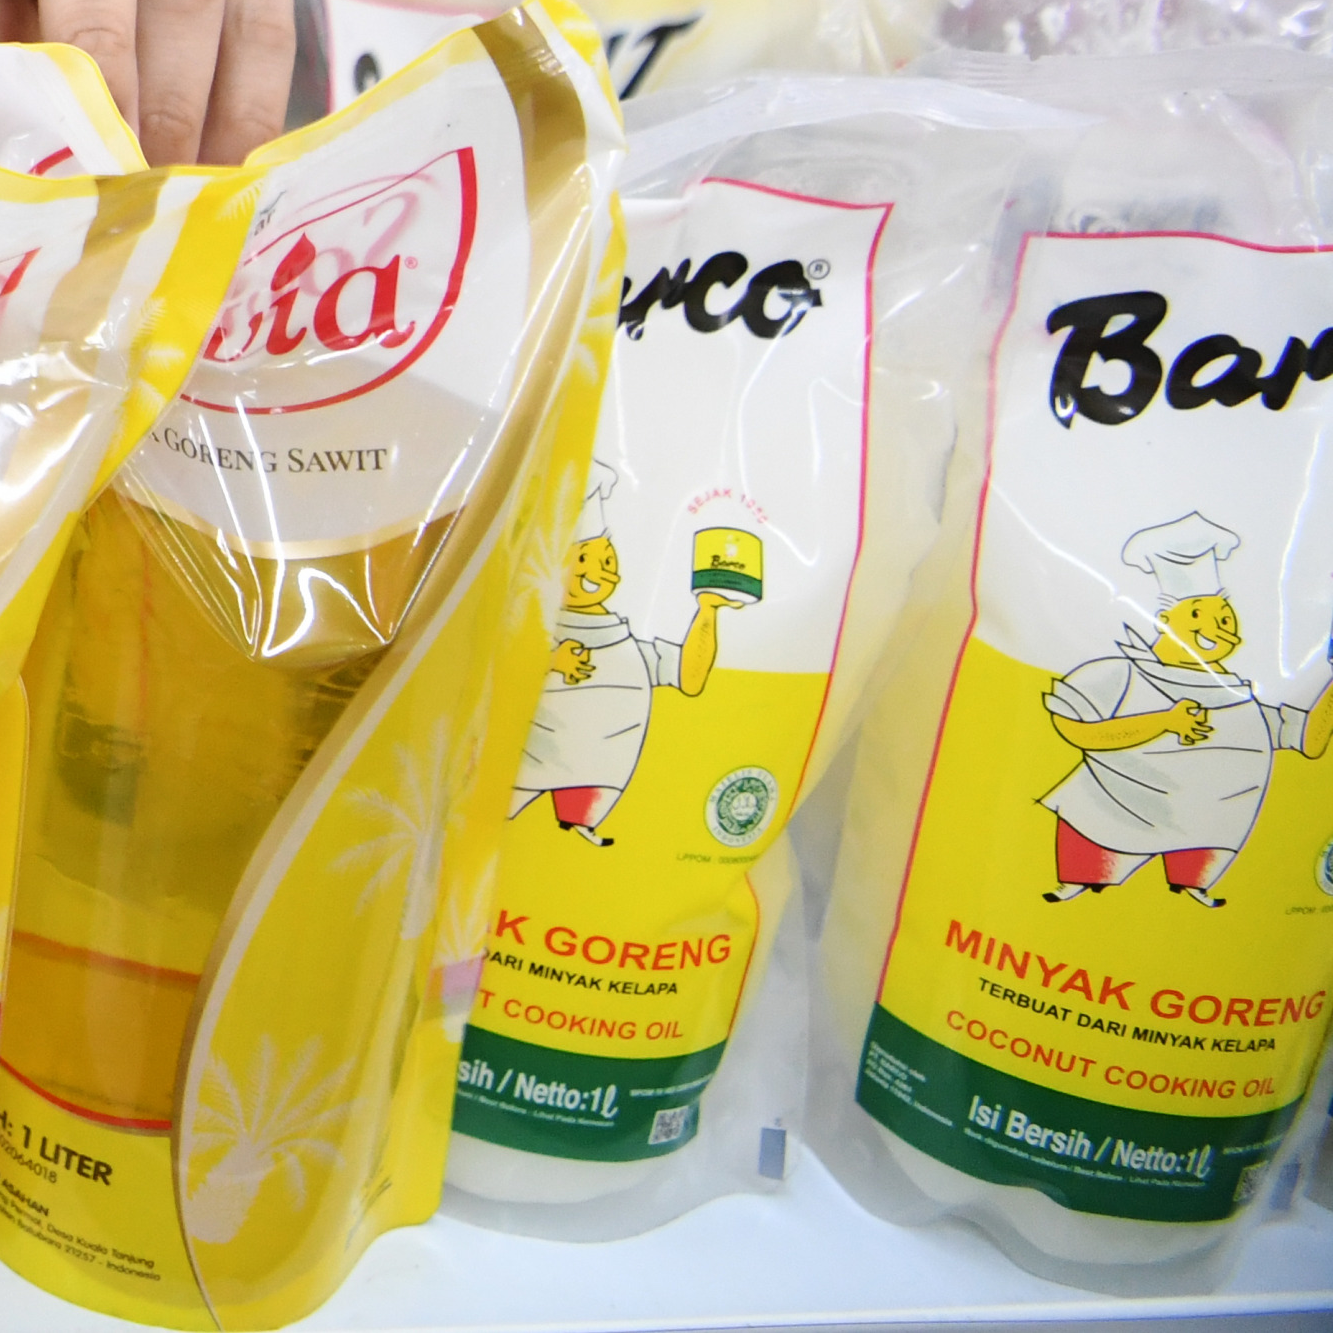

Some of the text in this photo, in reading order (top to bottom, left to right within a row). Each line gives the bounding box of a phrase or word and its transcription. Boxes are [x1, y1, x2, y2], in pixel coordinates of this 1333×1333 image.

[617, 250, 823, 341] rco
[1046, 290, 1333, 430] Bar
[164, 428, 388, 473] GORENG SAWIT
[529, 962, 603, 991] MINYAK
[608, 981, 678, 996] KELAPA
[544, 925, 732, 971] GORENG
[944, 918, 1326, 1027] MINYAK GORENG
[503, 999, 684, 1040] COOKING OIL
[979, 977, 1276, 1053] TERBUAT DARI MINYAK KELAPA
[458, 1059, 495, 1093] sih
[946, 1009, 1098, 1079] COCONUT
[1104, 1065, 1235, 1100] COOKING
[1242, 1077, 1275, 1098] OIL
[22, 1124, 32, 1150] 1
[38, 1136, 114, 1187] LITER
[967, 1094, 1002, 1132] Isi
[1004, 1109, 1092, 1160] Bersih
